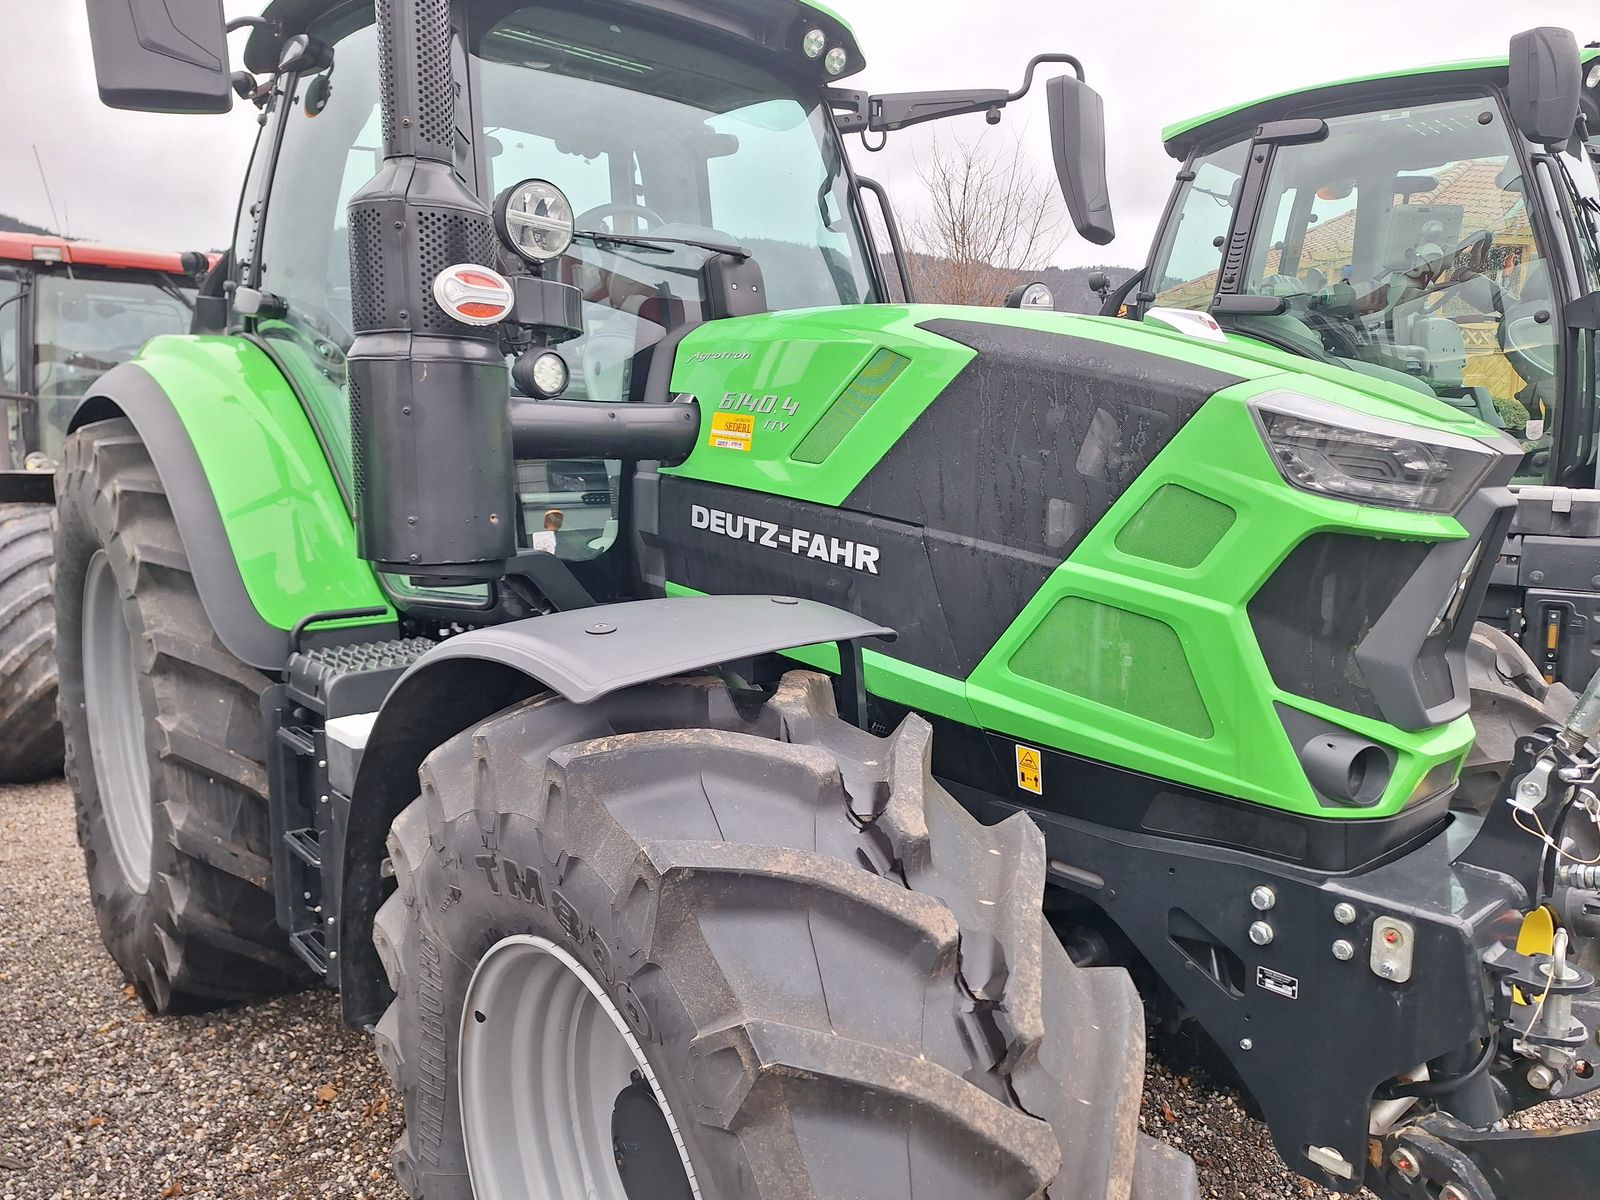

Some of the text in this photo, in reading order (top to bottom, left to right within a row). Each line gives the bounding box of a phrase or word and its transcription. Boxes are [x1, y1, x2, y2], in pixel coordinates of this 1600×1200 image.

[687, 351, 752, 364] Agrotron
[719, 391, 800, 416] 6140.4
[763, 419, 790, 431] TTV
[691, 504, 880, 575] DEUTZ-FAHR
